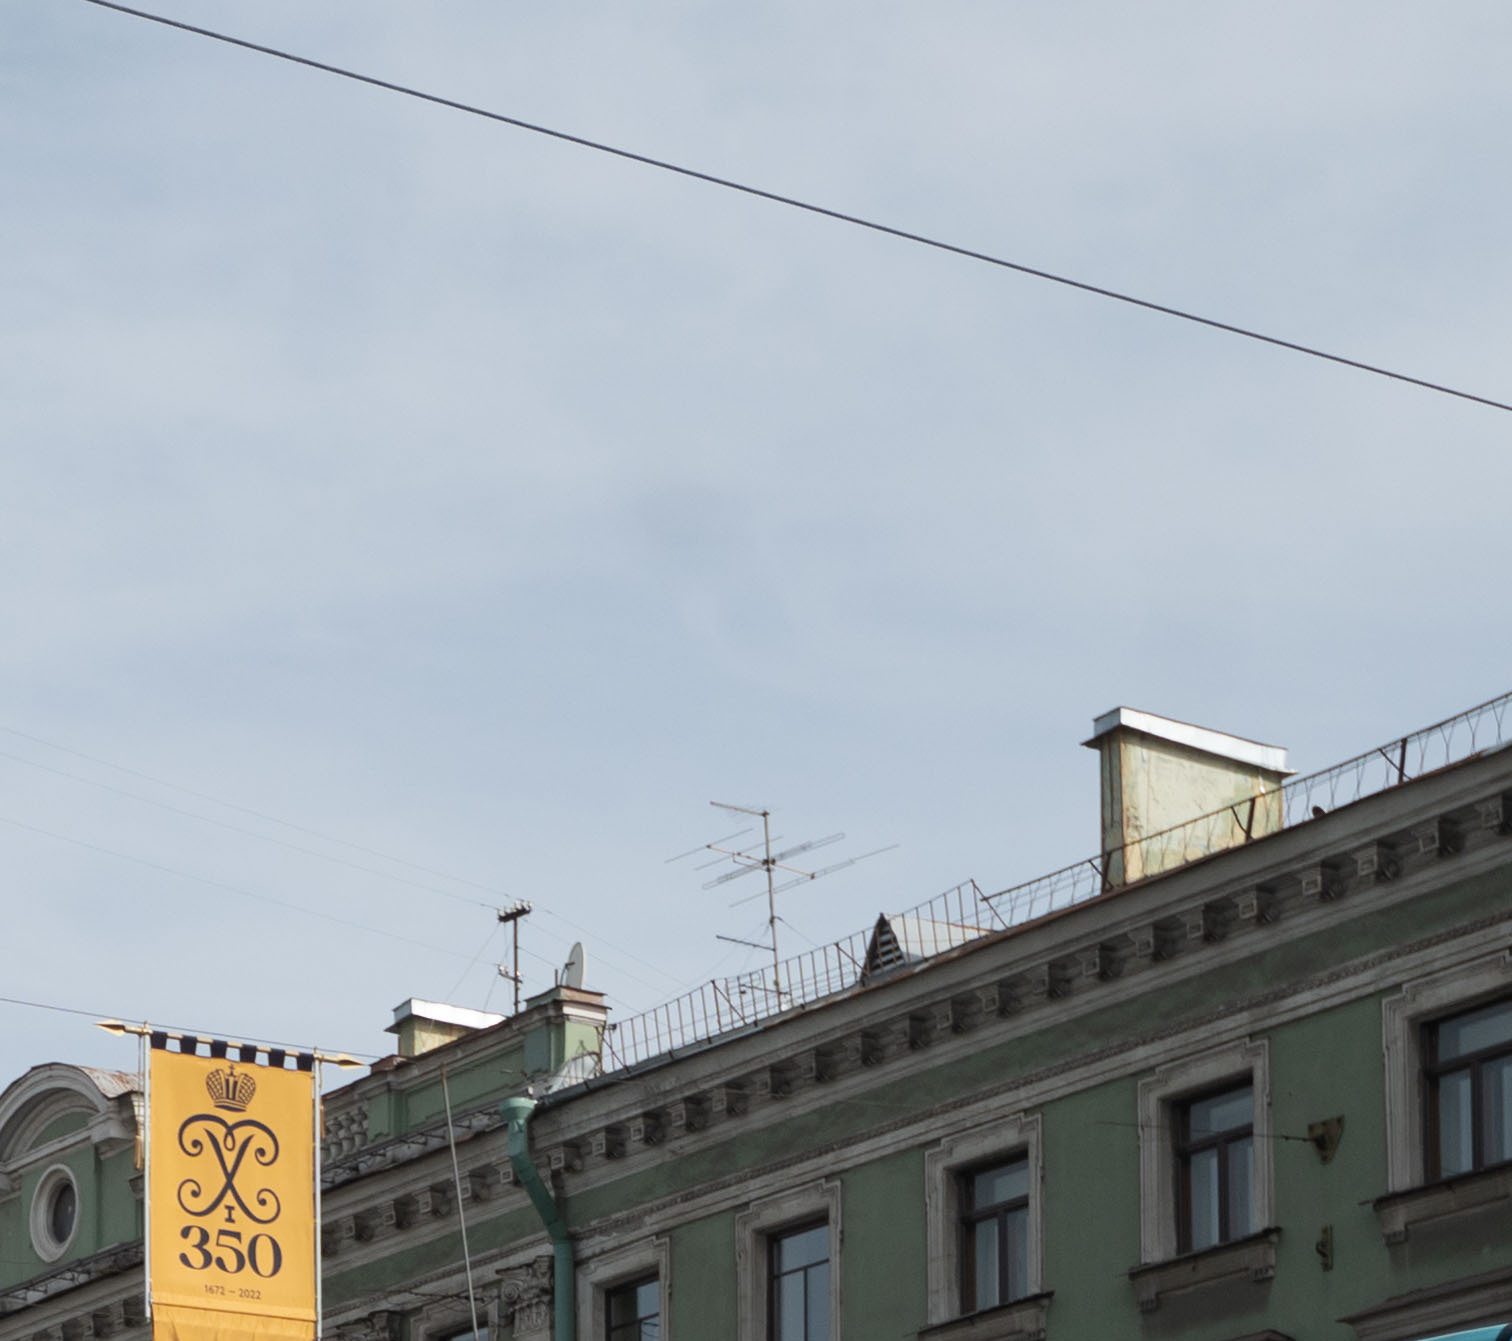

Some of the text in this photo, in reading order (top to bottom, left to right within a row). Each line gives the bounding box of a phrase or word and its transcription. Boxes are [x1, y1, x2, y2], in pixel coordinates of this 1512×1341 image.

[179, 1225, 282, 1278] 350
[204, 1284, 226, 1296] 1672
[238, 1288, 262, 1300] 2022
